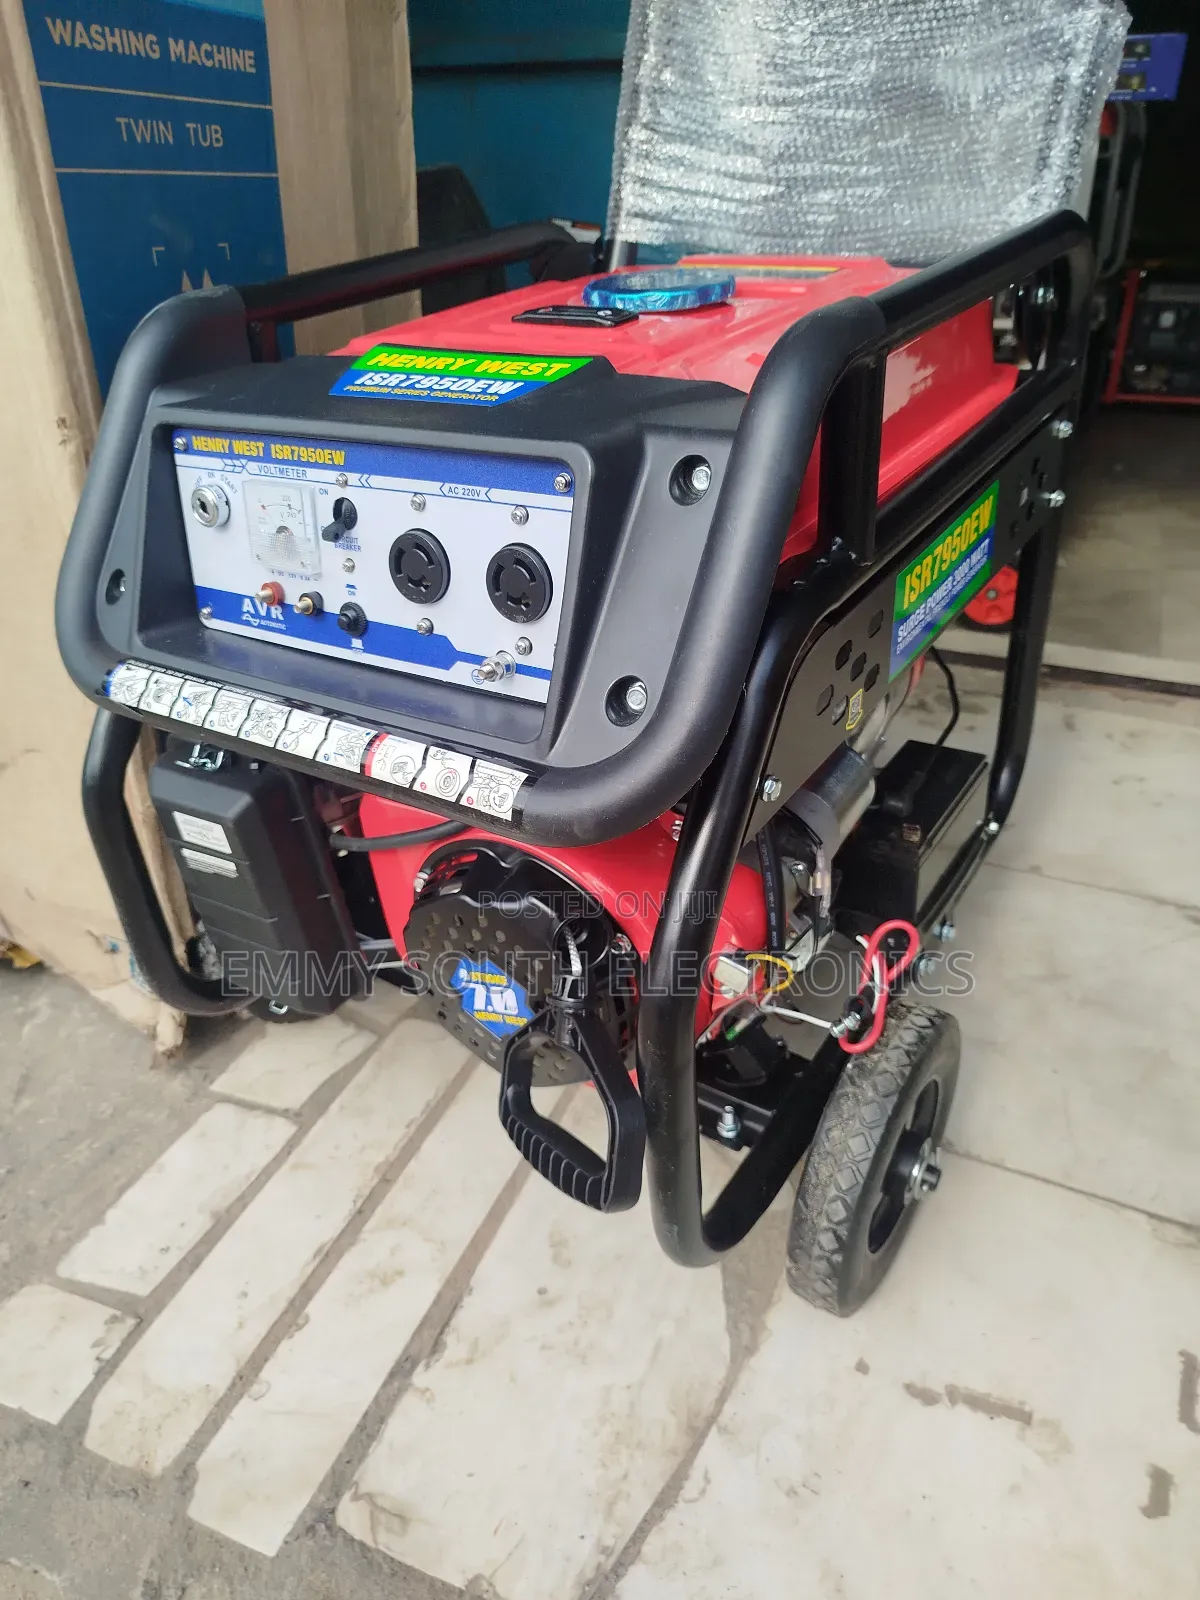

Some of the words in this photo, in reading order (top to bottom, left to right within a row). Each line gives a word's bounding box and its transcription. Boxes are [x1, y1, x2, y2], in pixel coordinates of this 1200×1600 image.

[45, 16, 161, 60] WASHING
[168, 37, 257, 74] MACHINE
[116, 117, 174, 145] TWIN
[185, 122, 224, 147] TUB
[366, 352, 477, 372] HENRY
[474, 359, 572, 377] WEST
[343, 385, 391, 394] PREMIUM
[391, 388, 430, 397] SERIES
[431, 390, 499, 402] GENERATOR
[354, 372, 525, 395] ISR7950EW
[192, 435, 229, 453] HENRY
[232, 440, 265, 457] WEST
[271, 444, 345, 466] ISR7950EW
[257, 465, 308, 479] VOLTMETER
[220, 475, 238, 494] START
[319, 488, 329, 496] ON
[447, 486, 460, 495] AC
[461, 487, 481, 498] 220V
[335, 543, 361, 552] BREAKER
[903, 495, 993, 610] ISR7950EW
[242, 598, 284, 621] AVR
[898, 603, 926, 643] SURGE
[926, 576, 953, 614] POWER
[246, 691, 277, 702] STARTING
